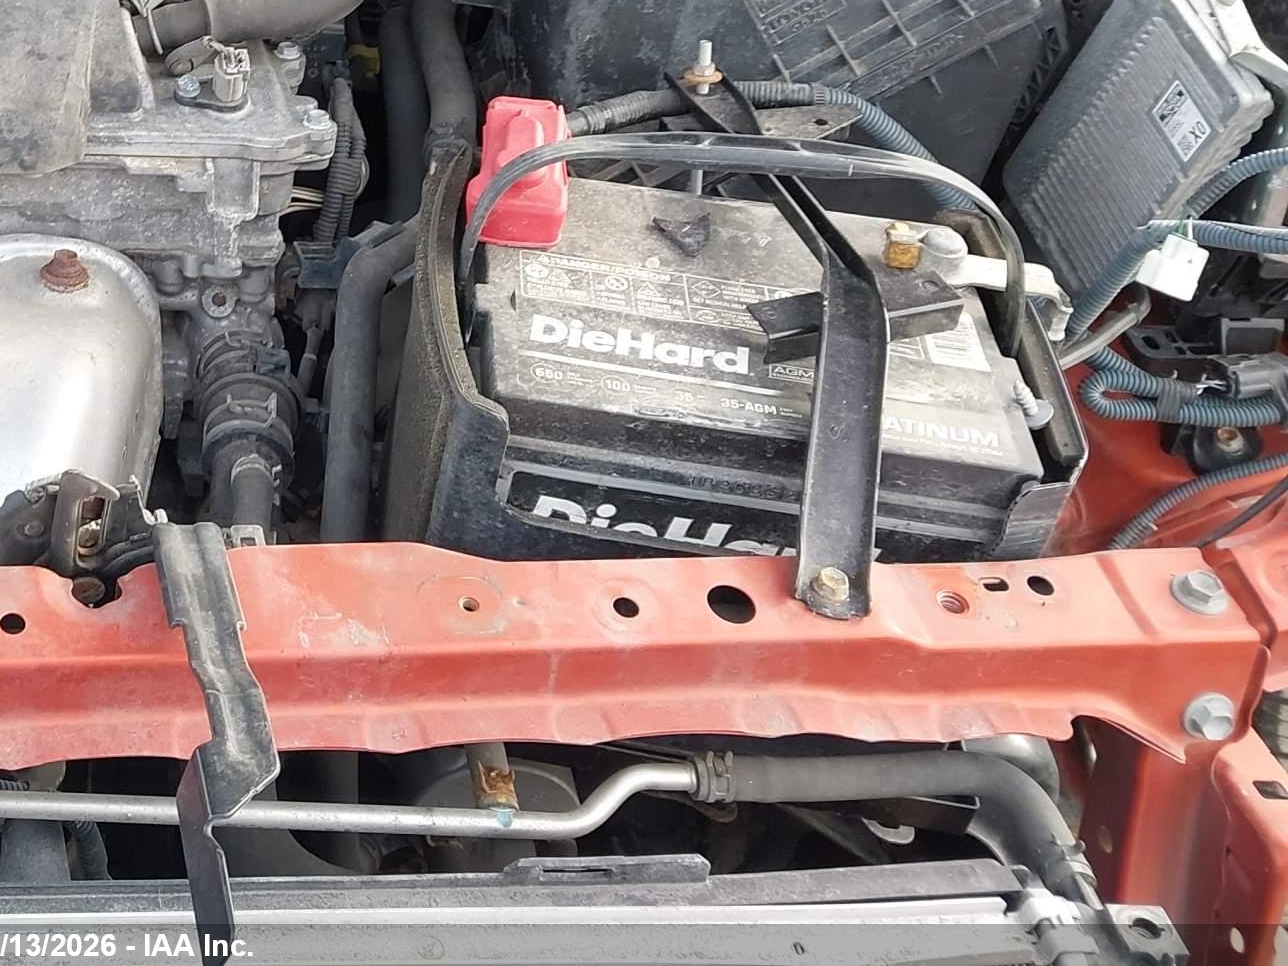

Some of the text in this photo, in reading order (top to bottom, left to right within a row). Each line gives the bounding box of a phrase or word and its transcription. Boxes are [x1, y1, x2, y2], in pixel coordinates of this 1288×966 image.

[529, 314, 749, 375] DieHard
[535, 367, 563, 380] 650
[773, 366, 815, 379] AGM
[606, 379, 630, 391] 100
[720, 398, 777, 414] 35-AGM
[883, 417, 1000, 448] ATINUM
